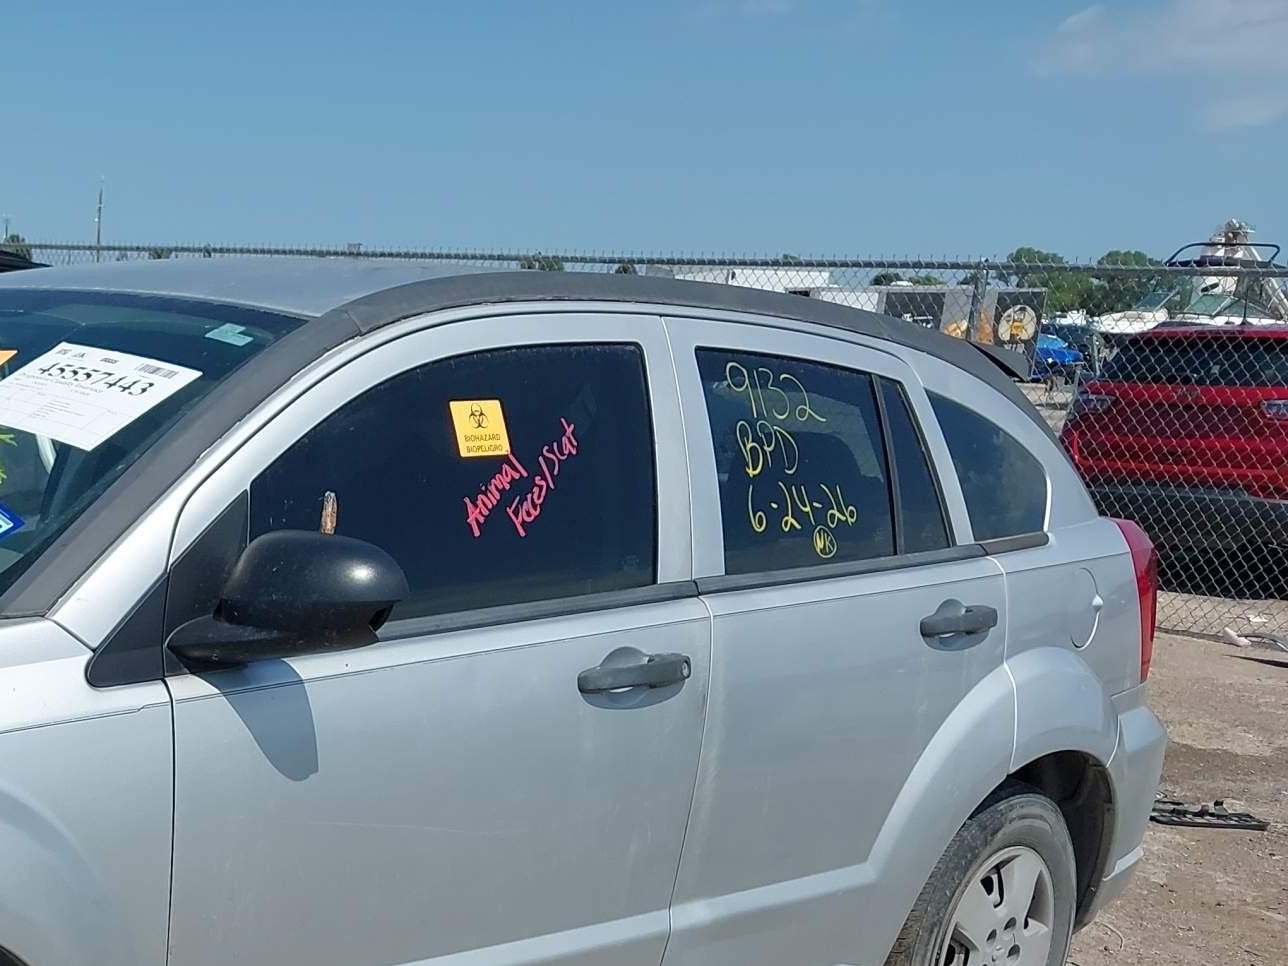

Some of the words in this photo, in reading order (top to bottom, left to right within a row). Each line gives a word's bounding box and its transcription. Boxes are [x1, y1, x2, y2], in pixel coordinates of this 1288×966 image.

[39, 362, 155, 396] 45557443
[725, 361, 827, 422] 9132
[464, 433, 501, 443] BIOHAZARD
[736, 420, 799, 478] BPD
[463, 453, 528, 537] Animal
[748, 481, 857, 532] 6-24-26
